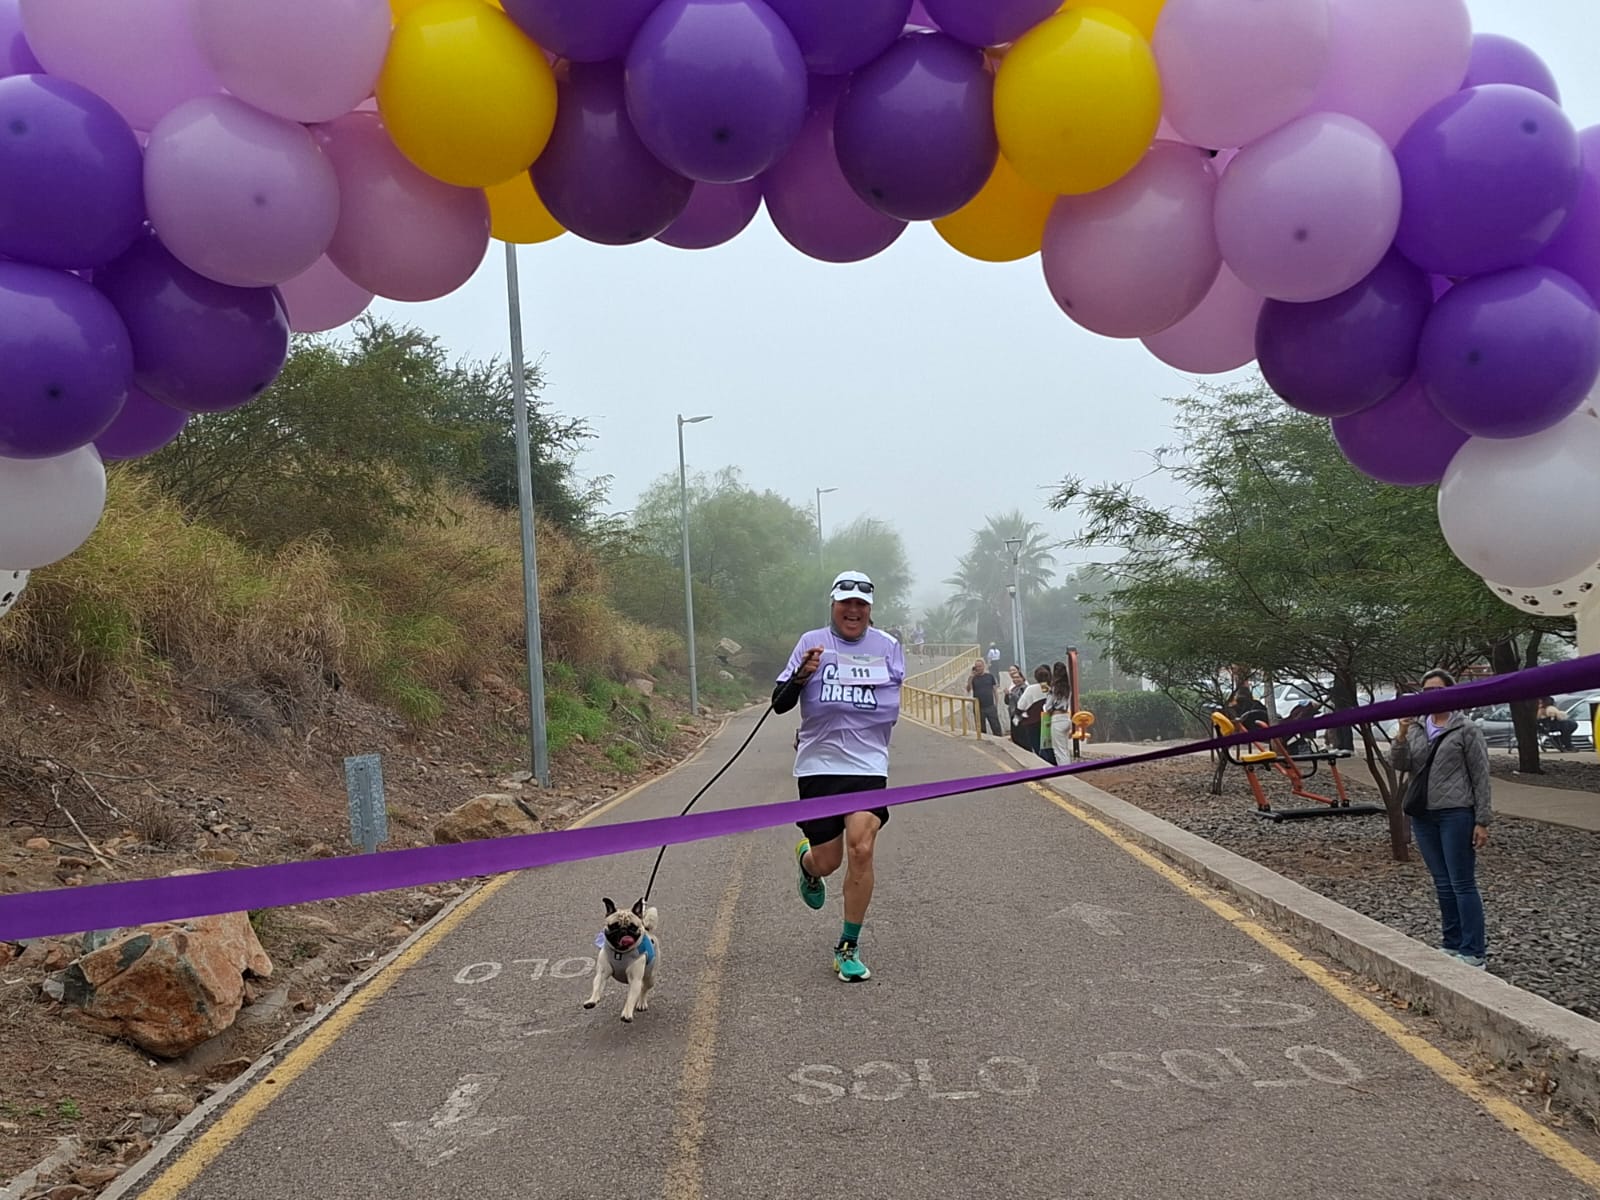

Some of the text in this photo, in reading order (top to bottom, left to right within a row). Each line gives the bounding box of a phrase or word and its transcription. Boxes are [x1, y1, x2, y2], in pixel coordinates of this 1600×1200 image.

[850, 667, 871, 678] 111
[821, 684, 877, 704] RRERA
[787, 1055, 1040, 1104] SOLO
[1096, 1045, 1363, 1092] SOLO
